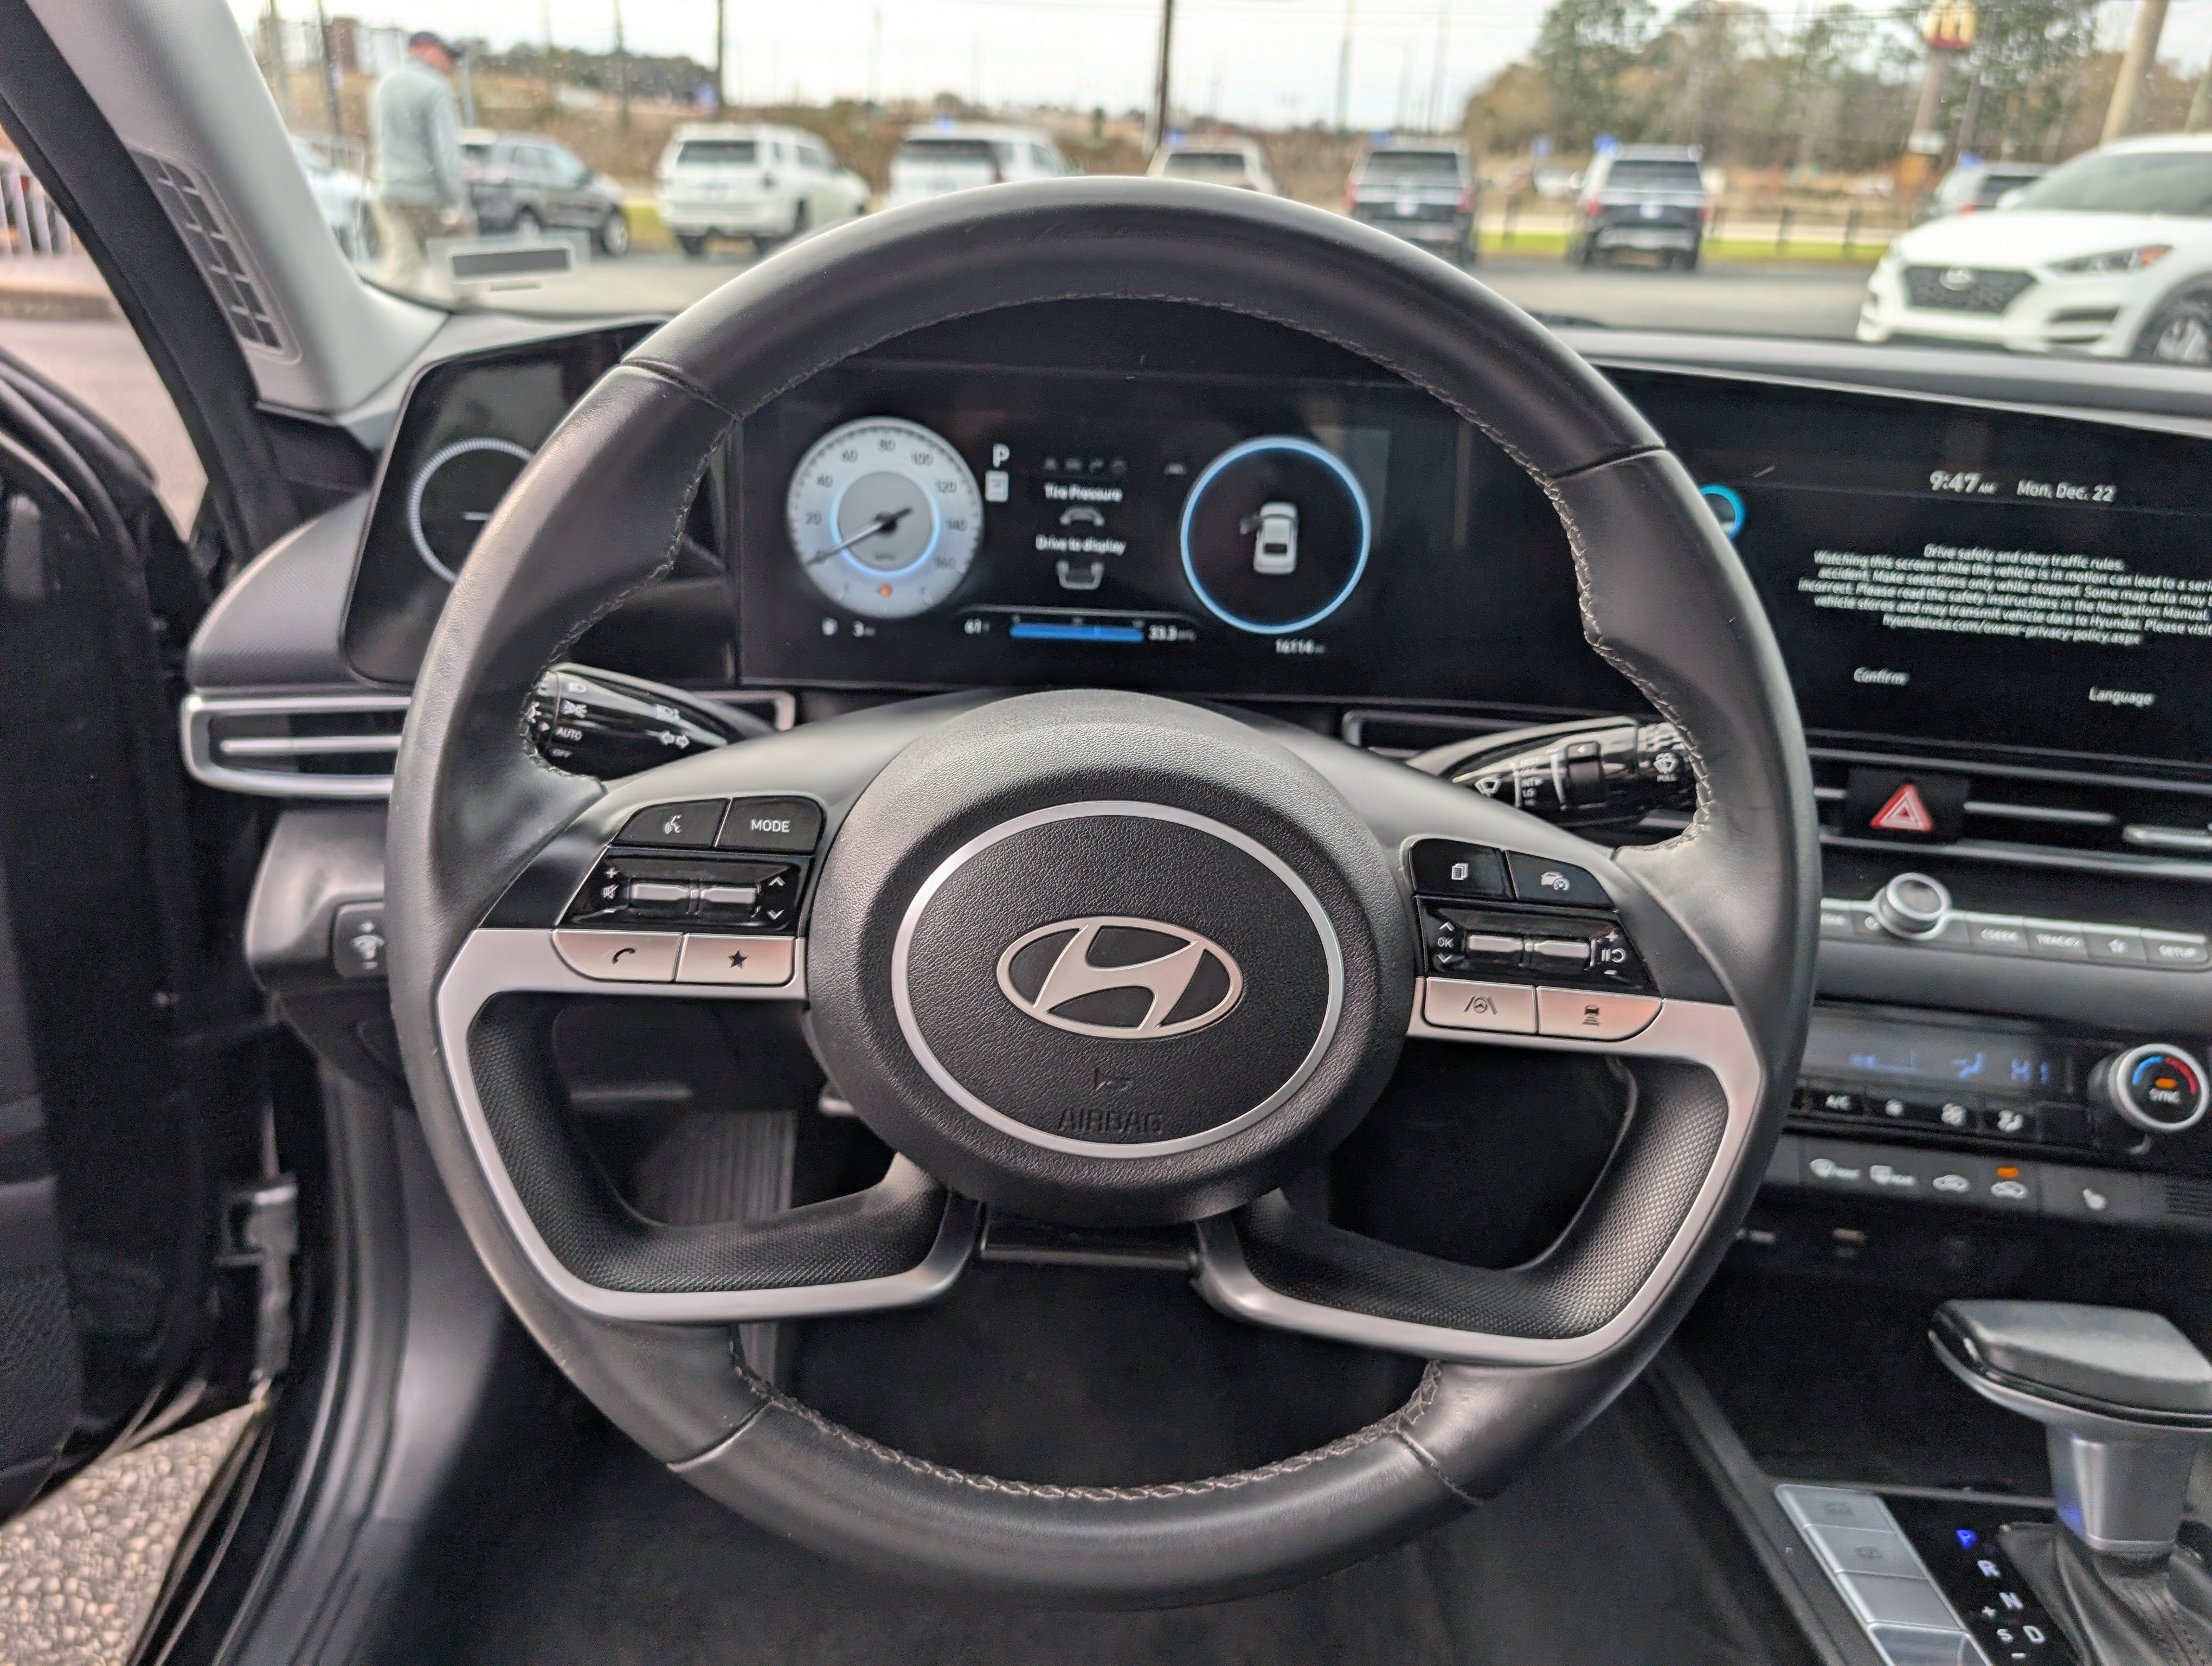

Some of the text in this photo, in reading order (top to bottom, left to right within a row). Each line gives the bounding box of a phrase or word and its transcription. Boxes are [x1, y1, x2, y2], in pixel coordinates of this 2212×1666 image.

[911, 452, 934, 466] 100
[993, 443, 1010, 467] P
[1930, 470, 1980, 493] 9:47
[2017, 479, 2117, 502] Mon. Dec. 22
[1044, 482, 1123, 502] Tire Pressure
[1036, 534, 1068, 551] Drive
[1924, 543, 1957, 559] Drive
[1995, 549, 2020, 564] and
[2109, 574, 2134, 586] can
[2134, 573, 2162, 588] lead
[1854, 667, 1910, 686] Confirm
[2088, 685, 2157, 708] Language
[556, 726, 583, 741] AUTO
[750, 818, 791, 833] MODE
[1437, 937, 1454, 949] OK
[1058, 1107, 1164, 1133] AIRBAG
[1956, 1528, 1977, 1549] P
[1977, 1560, 2001, 1578] R
[1999, 1592, 2023, 1610] N
[1997, 1628, 2014, 1643] S
[2022, 1625, 2045, 1644] D
